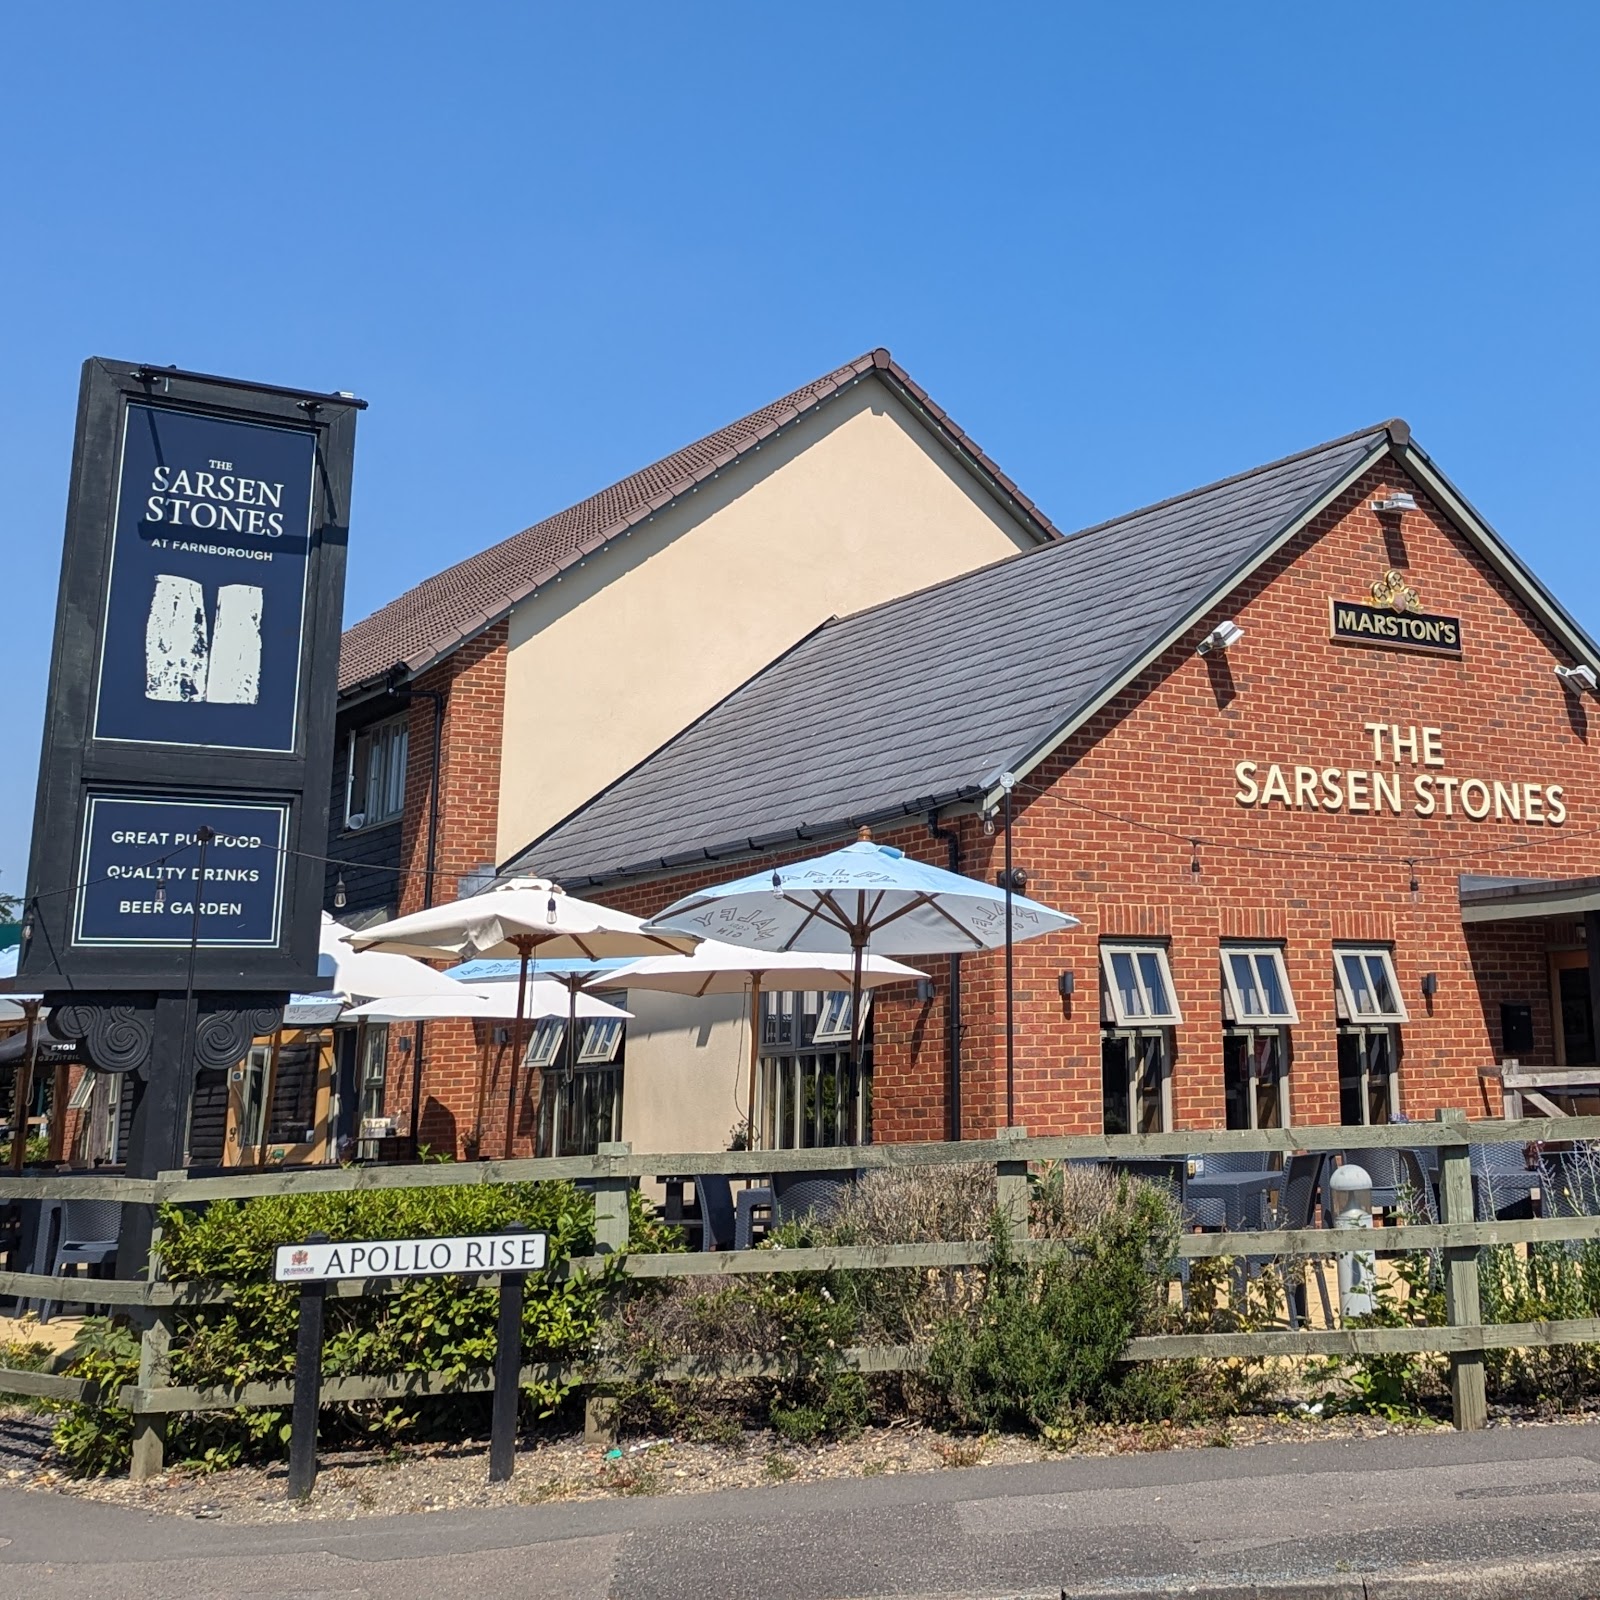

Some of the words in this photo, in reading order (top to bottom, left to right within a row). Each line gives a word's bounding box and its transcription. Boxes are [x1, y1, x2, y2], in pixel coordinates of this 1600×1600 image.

[209, 459, 233, 471] THE
[152, 466, 284, 508] SARSEN
[145, 496, 284, 538] STONES
[151, 539, 169, 549] AT
[172, 540, 273, 562] FARNBOROUGH
[1338, 609, 1456, 644] MARSTON'S
[1364, 722, 1445, 767] THE
[1234, 761, 1401, 814] SARSEN
[1413, 774, 1567, 824] STONES
[111, 831, 169, 845] GREAT
[174, 833, 209, 846] PU
[214, 835, 261, 848] FOOD
[107, 865, 186, 880] QUALITY
[191, 867, 259, 882] DRINKS
[119, 901, 164, 914] BEER
[170, 902, 242, 915] GARDEN
[323, 1243, 452, 1275] APOLLO
[465, 1238, 536, 1268] RISE
